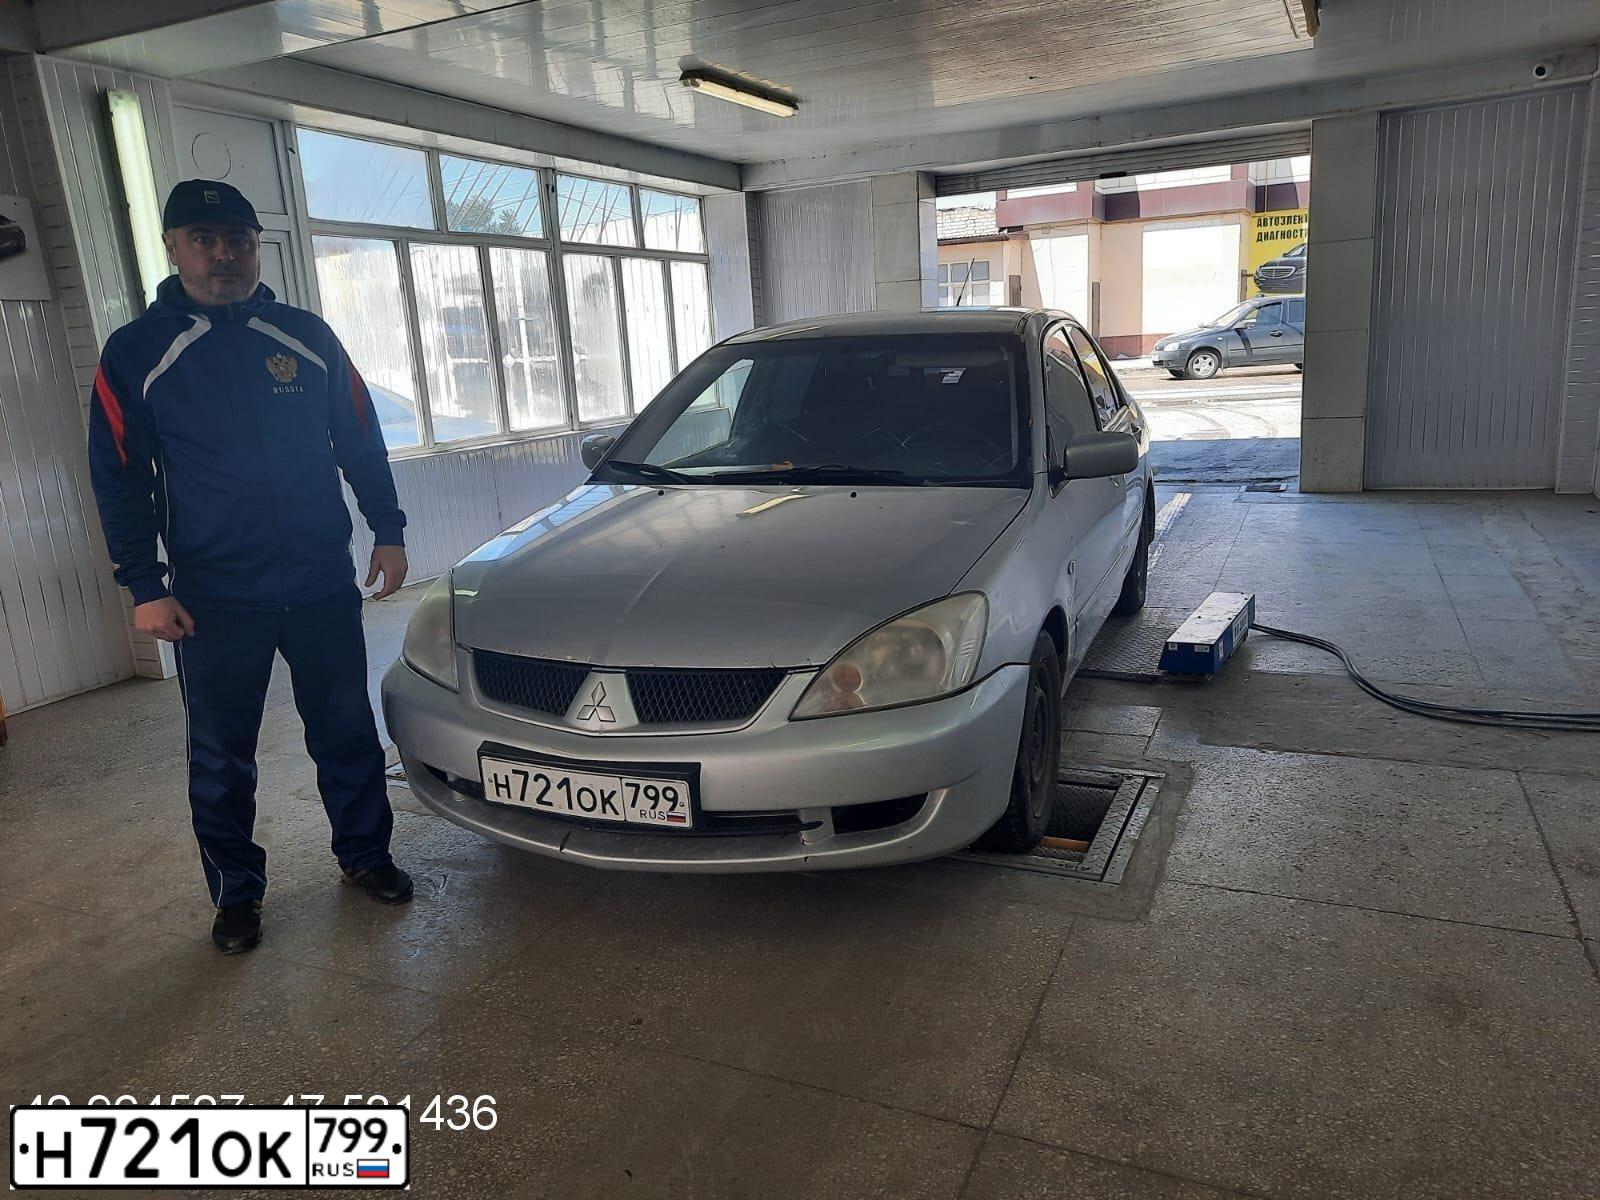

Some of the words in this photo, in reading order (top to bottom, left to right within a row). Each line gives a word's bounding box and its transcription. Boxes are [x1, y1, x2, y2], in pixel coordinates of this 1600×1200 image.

[272, 385, 304, 394] RUSSIA
[624, 782, 679, 812] 799
[640, 809, 666, 821] RUS
